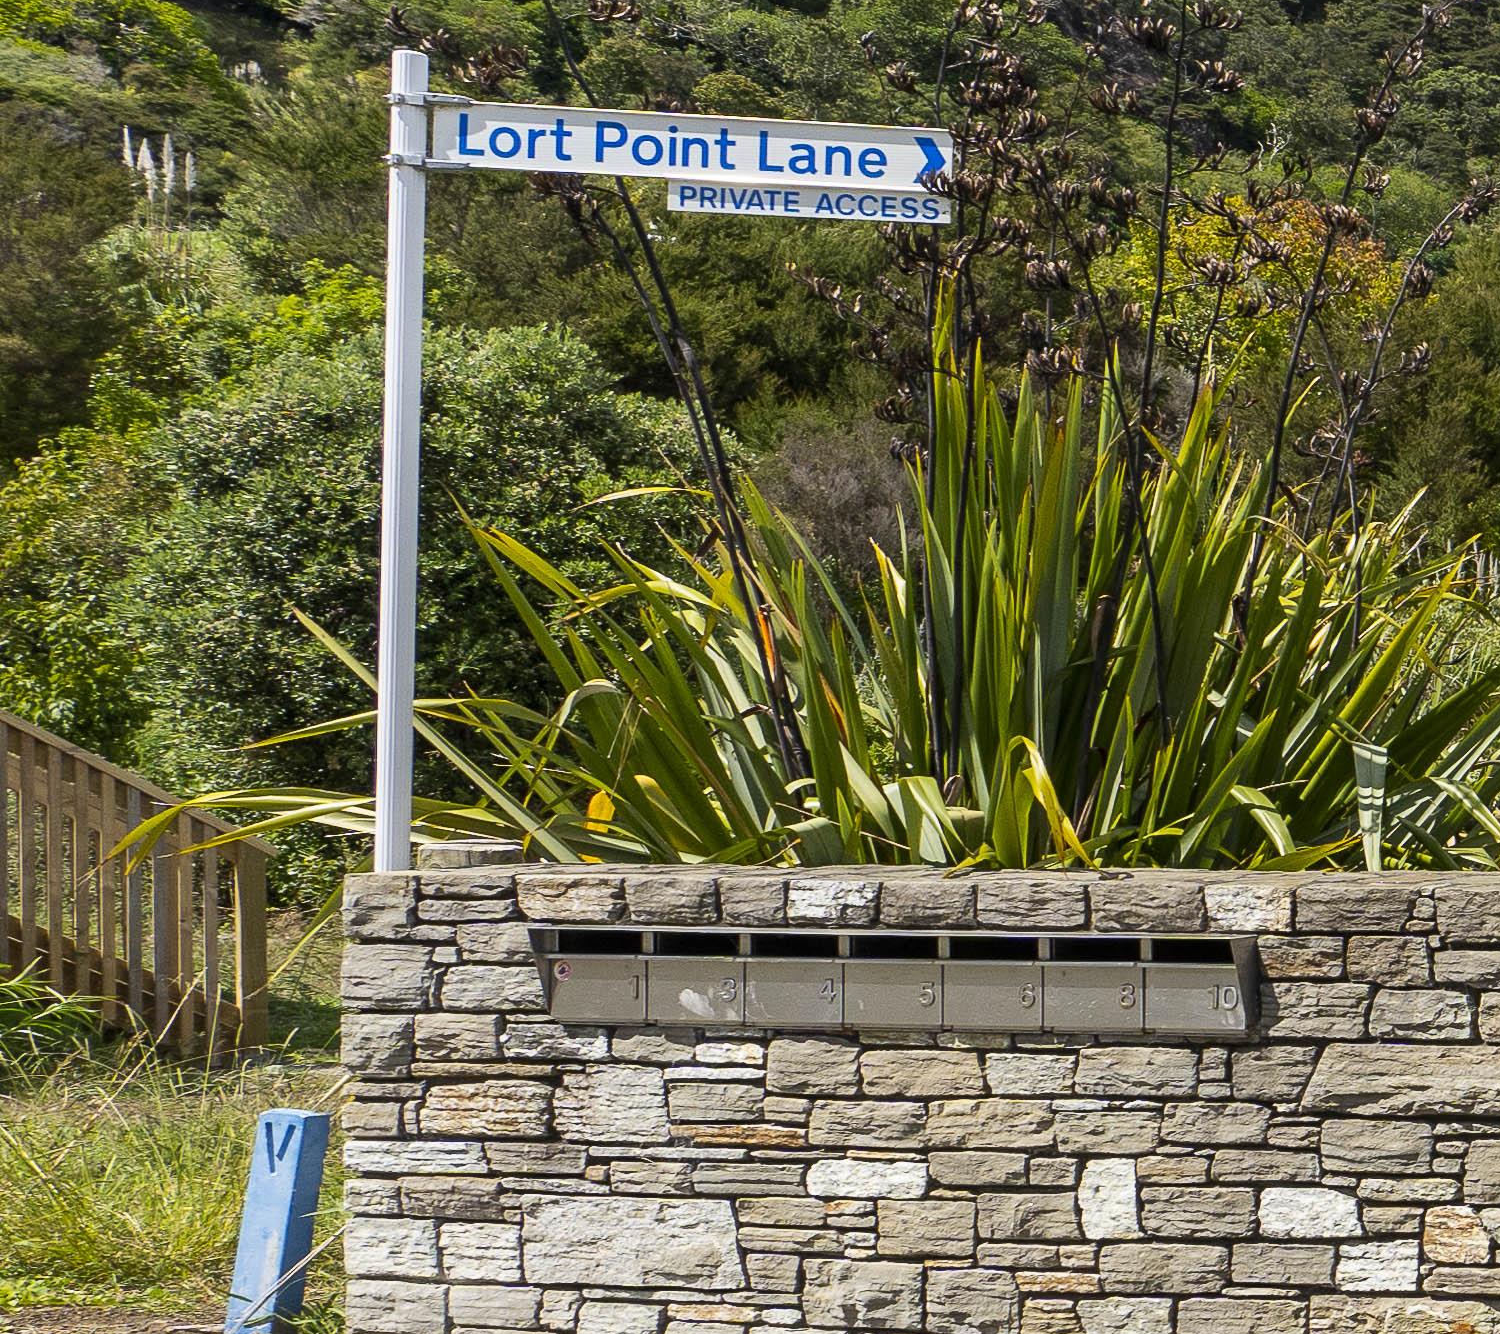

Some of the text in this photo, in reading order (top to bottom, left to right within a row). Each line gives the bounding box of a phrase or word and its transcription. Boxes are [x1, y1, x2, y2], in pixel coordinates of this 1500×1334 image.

[458, 113, 888, 179] Lort Point Lane
[679, 185, 940, 220] PRIVATE ACCESS
[629, 975, 640, 1000] 1
[819, 978, 837, 1003] 4
[919, 981, 936, 1007] 5
[1019, 982, 1036, 1008] 6
[1119, 983, 1136, 1009] 8
[1208, 984, 1239, 1011] 10
